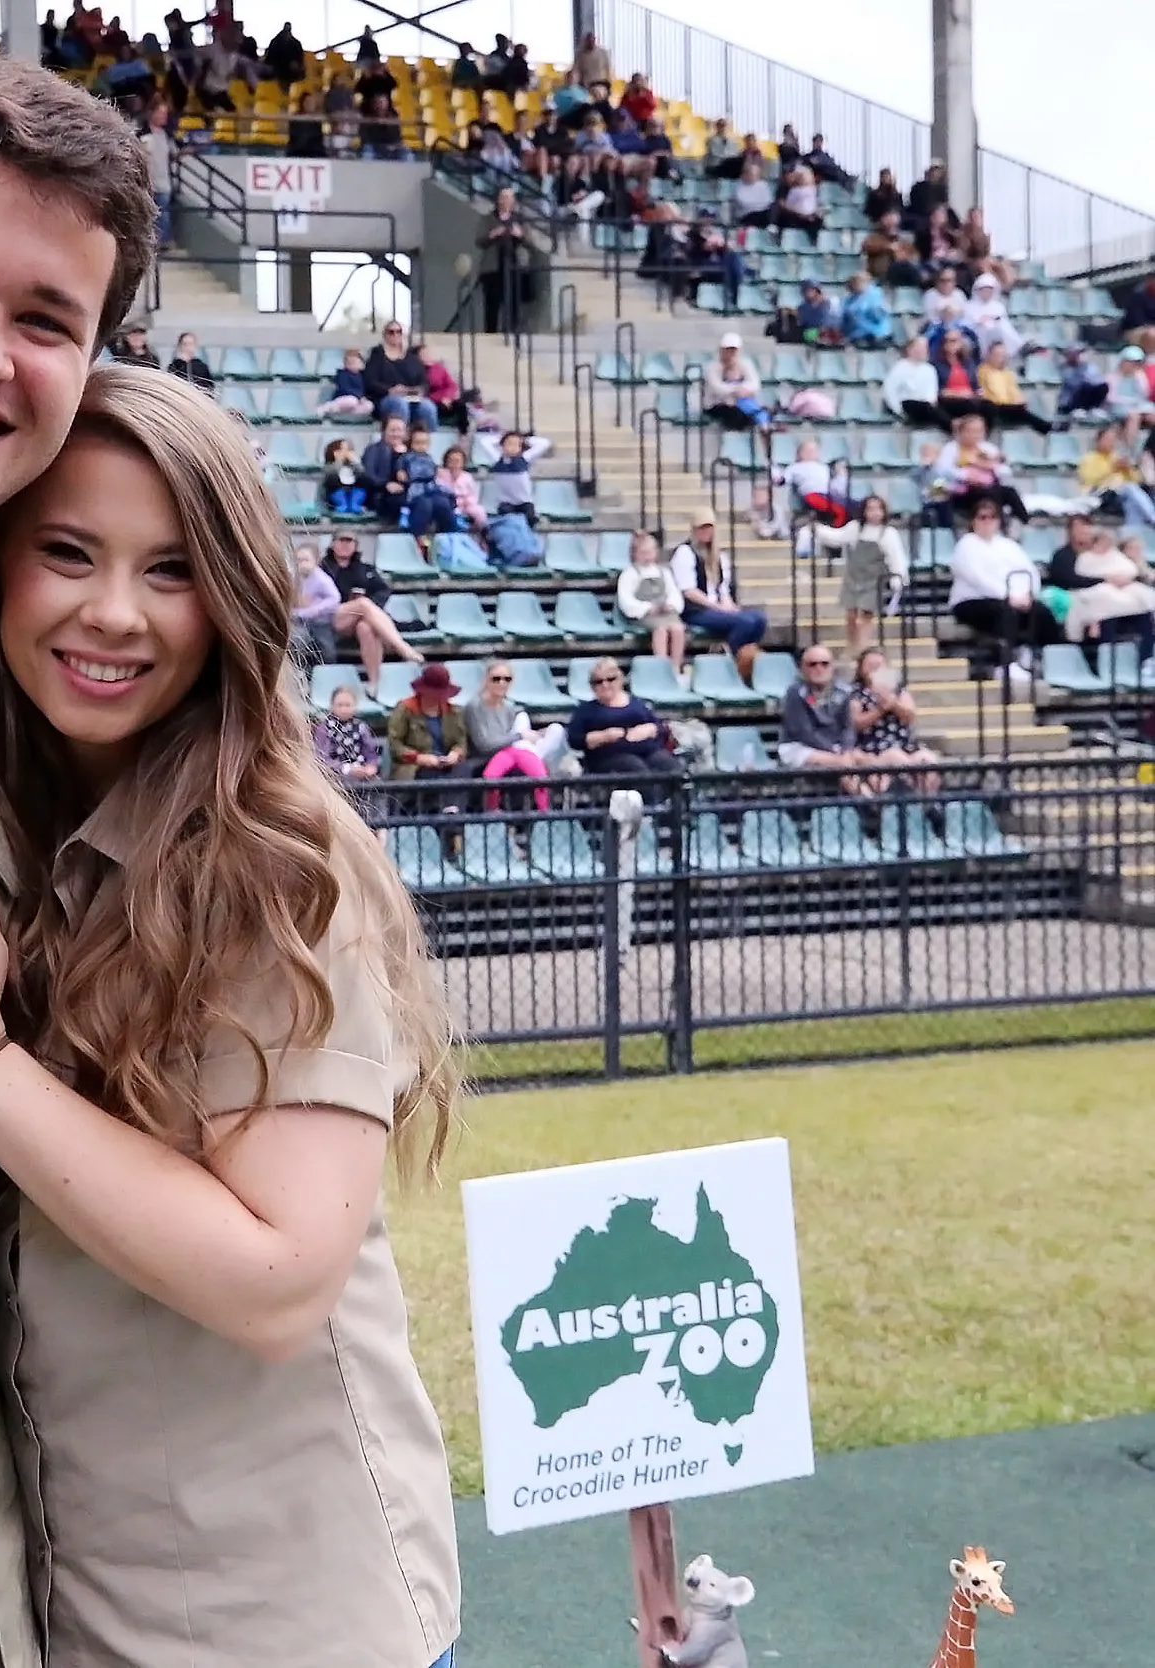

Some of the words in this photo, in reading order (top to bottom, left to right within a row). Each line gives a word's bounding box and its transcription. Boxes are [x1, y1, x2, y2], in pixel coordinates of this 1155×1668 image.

[251, 163, 325, 192] EXIT
[515, 1277, 764, 1353] Australia
[633, 1318, 767, 1382] ZOO
[536, 1450, 604, 1476] Home
[611, 1438, 634, 1463] of
[641, 1434, 682, 1457] The
[513, 1472, 625, 1508] Crocodile
[633, 1457, 709, 1486] Hunter
